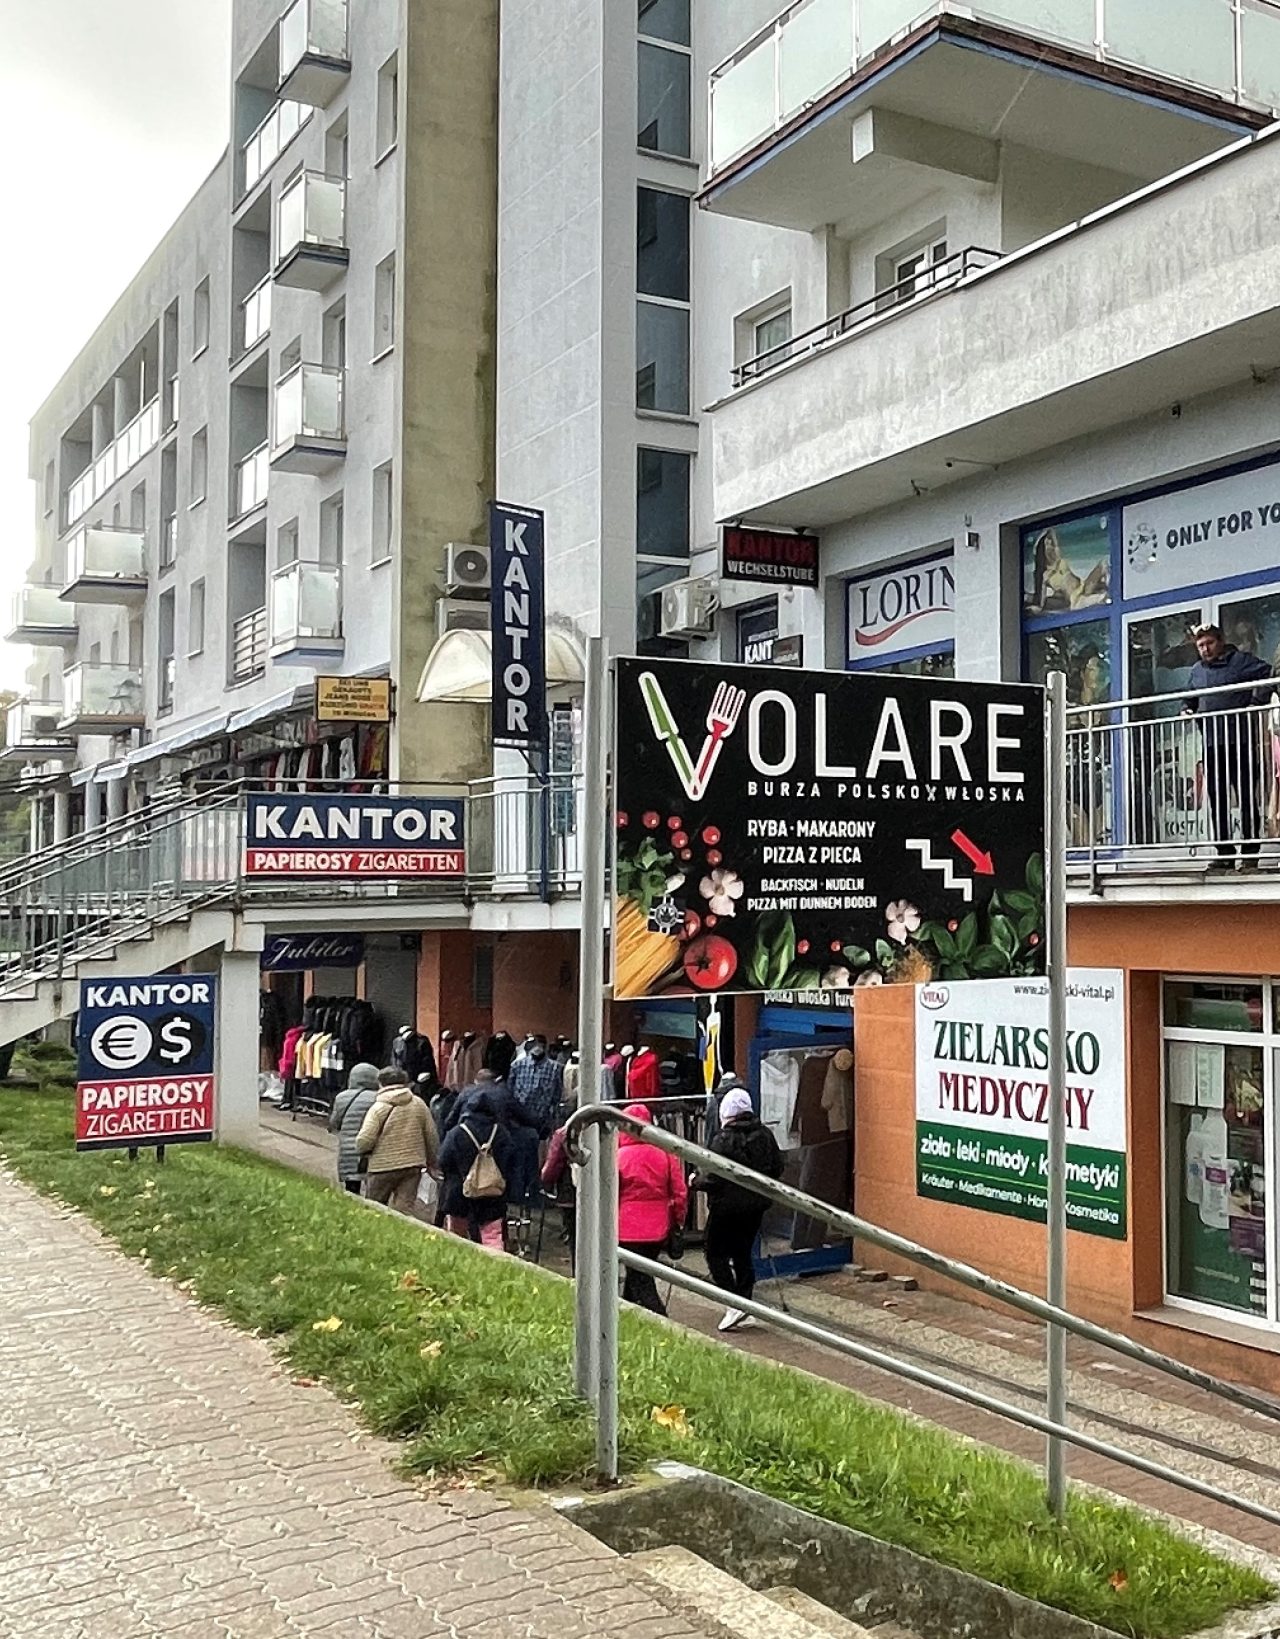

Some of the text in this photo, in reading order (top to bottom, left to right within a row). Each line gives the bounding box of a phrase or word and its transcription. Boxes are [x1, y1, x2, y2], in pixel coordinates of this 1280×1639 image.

[1166, 520, 1212, 549] ONLY
[1217, 510, 1253, 537] FOR
[727, 560, 815, 581] WECHSELSTUBE
[859, 566, 955, 629] LORIN
[503, 518, 530, 733] KANTOR
[748, 781, 820, 797] BURZA
[838, 783, 919, 799] POLSKO
[945, 786, 1025, 801] WŁOSKA
[254, 805, 458, 841] KANTOR
[747, 819, 876, 838] RYBA MAKARONY
[254, 851, 458, 871] PAPIEROSY ZIGARETTEN
[763, 846, 862, 864] PIZZA Z PIECA
[761, 878, 864, 892] BACKFISCH NUDELN
[747, 898, 778, 911] PIZZA
[779, 897, 797, 910] MIT
[844, 895, 877, 909] BODEN
[263, 937, 354, 966] Jubiler
[87, 983, 210, 1007] KANTOR
[922, 991, 945, 1003] VITAL
[1014, 983, 1114, 1001] www.ziski-vital.pl
[160, 1016, 192, 1063] $
[82, 1080, 209, 1110] PAPIEROSY
[86, 1109, 205, 1136] ZIGARETTEN
[920, 1133, 1119, 1191] zioła leki miody kmetyki
[958, 1179, 1023, 1204] Medikamente
